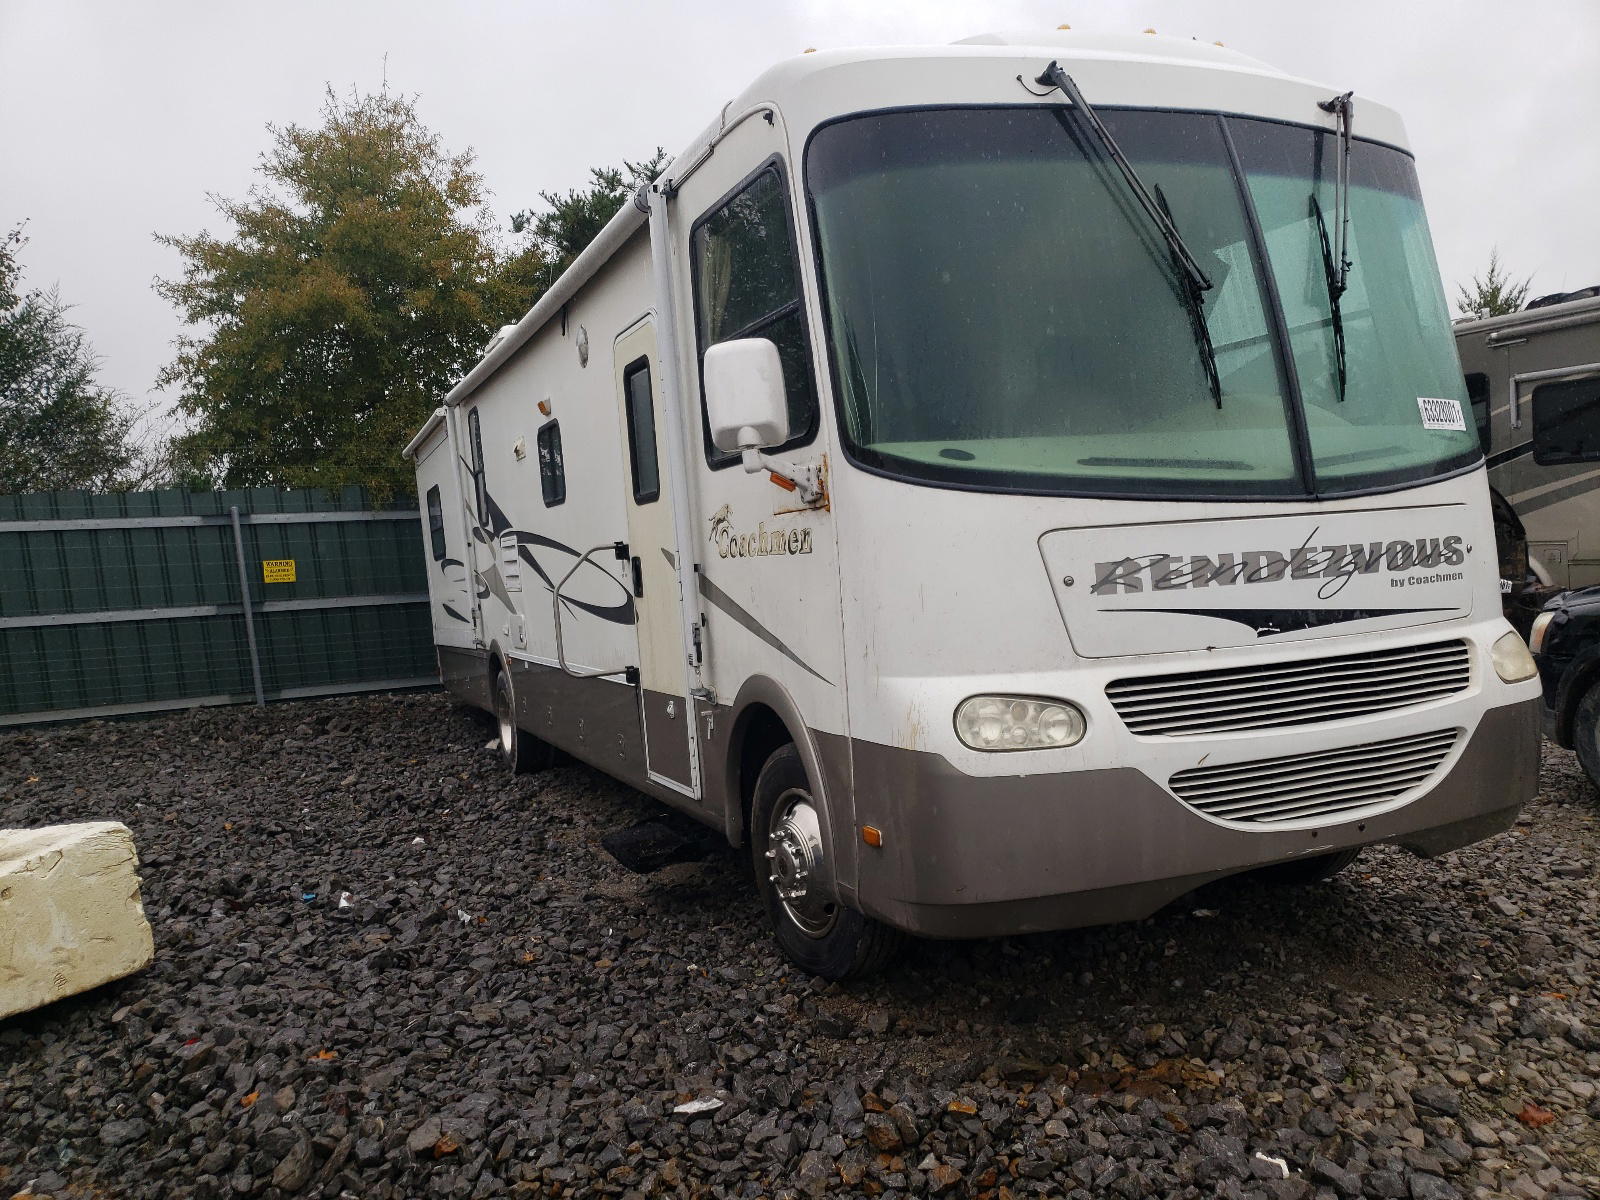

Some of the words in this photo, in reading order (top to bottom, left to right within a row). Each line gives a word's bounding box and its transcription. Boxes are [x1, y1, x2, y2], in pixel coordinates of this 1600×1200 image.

[718, 521, 813, 558] Coachmen
[1095, 535, 1464, 595] RENDEZVOUS
[1390, 578, 1405, 588] by
[1407, 572, 1464, 586] Coachmen
